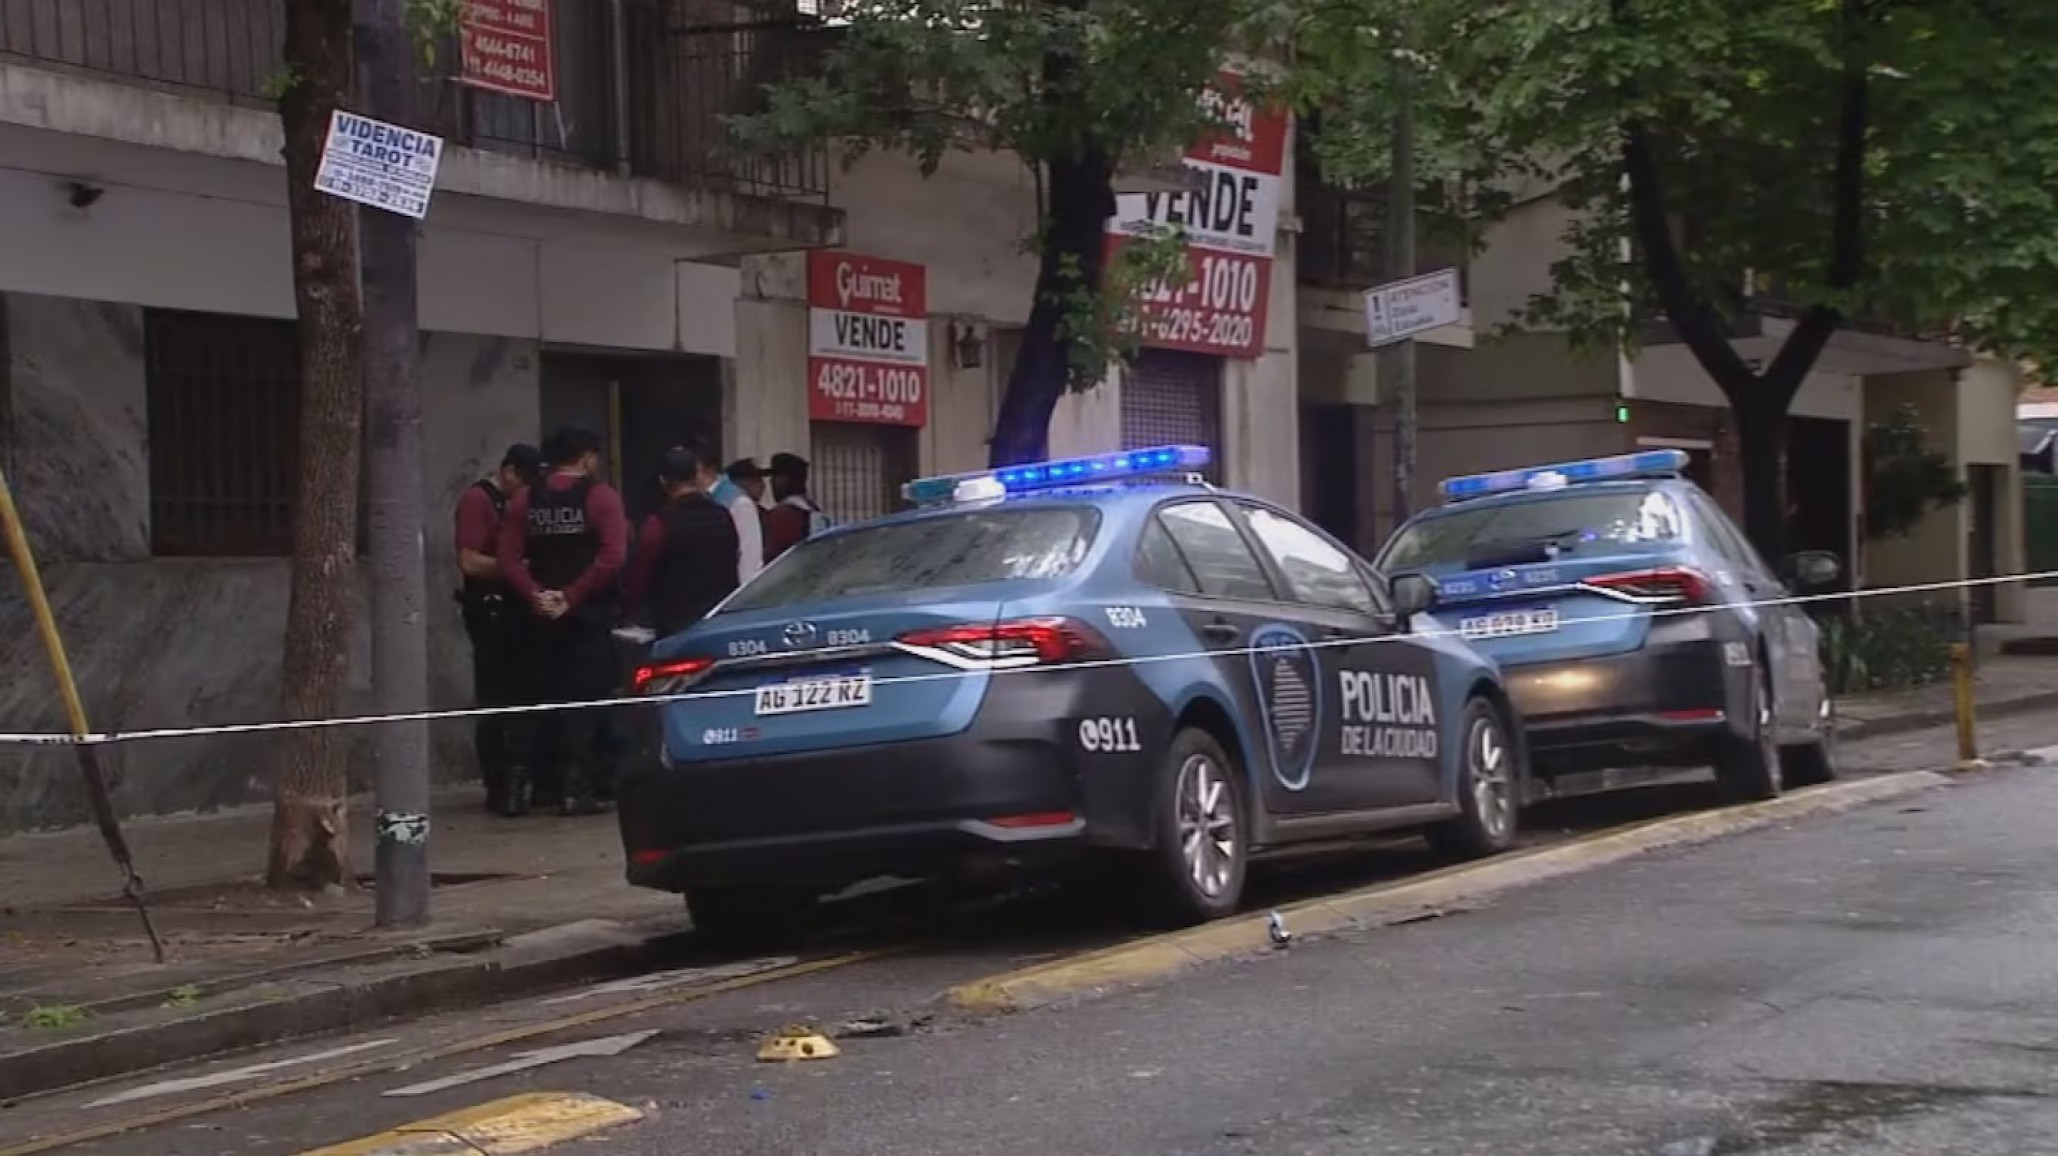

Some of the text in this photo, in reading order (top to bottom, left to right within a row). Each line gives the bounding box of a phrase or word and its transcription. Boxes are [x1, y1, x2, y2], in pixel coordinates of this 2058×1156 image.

[337, 114, 435, 158] VIDENCIA
[352, 140, 414, 166] TAROT
[835, 312, 906, 351] VENDE
[818, 362, 921, 404] 4821-1010
[528, 507, 584, 525] POLICIA
[1105, 607, 1147, 628] 8304
[728, 639, 767, 656] 8304
[827, 629, 870, 646] 8304
[759, 690, 786, 711] AG
[792, 683, 833, 706] 122
[1339, 669, 1436, 725] POLICIA
[1099, 716, 1142, 751] 911
[1341, 725, 1437, 758] DE LA CIUDAD
